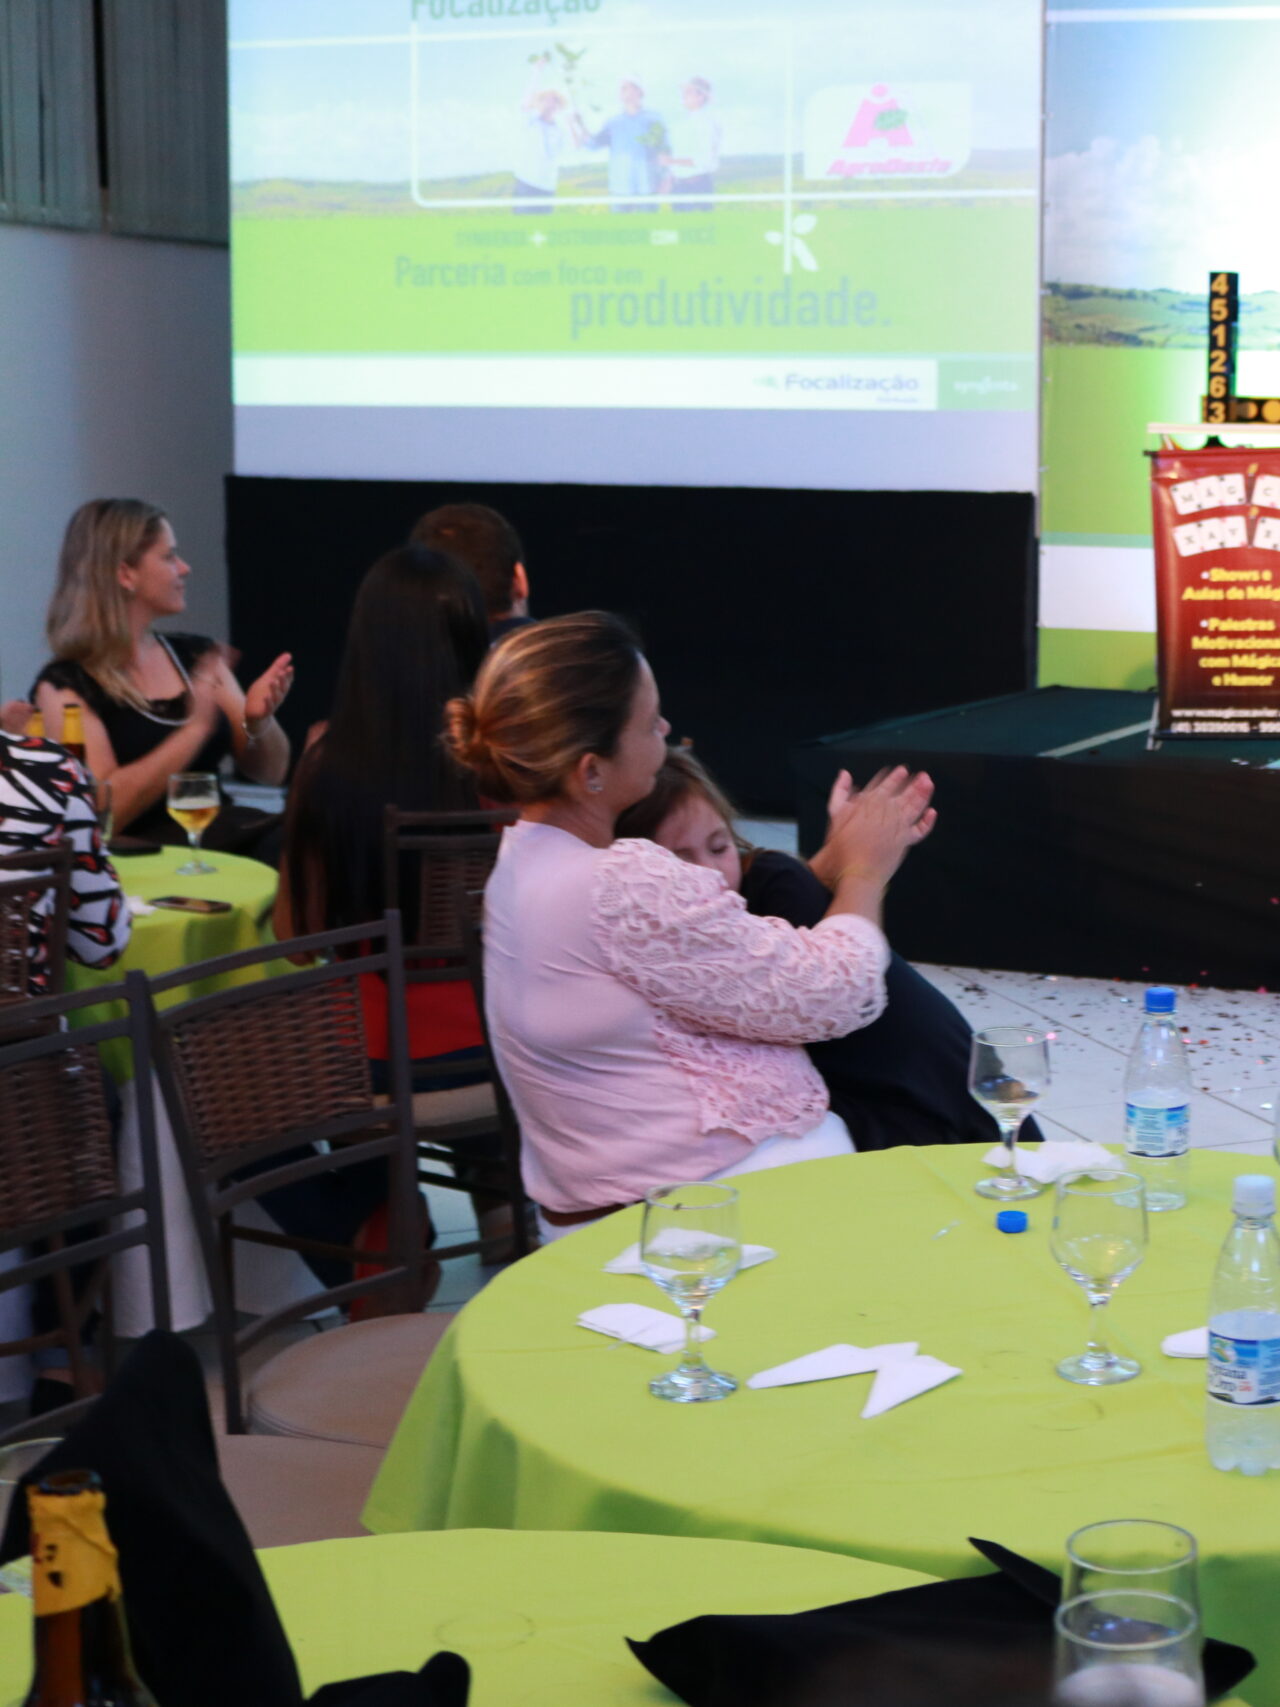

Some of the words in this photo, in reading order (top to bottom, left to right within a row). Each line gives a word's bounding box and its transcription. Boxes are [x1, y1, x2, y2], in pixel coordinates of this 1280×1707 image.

[395, 254, 507, 288] Parceria
[558, 258, 608, 285] foco
[570, 277, 892, 340] produtividade.
[785, 372, 919, 393] Focalização
